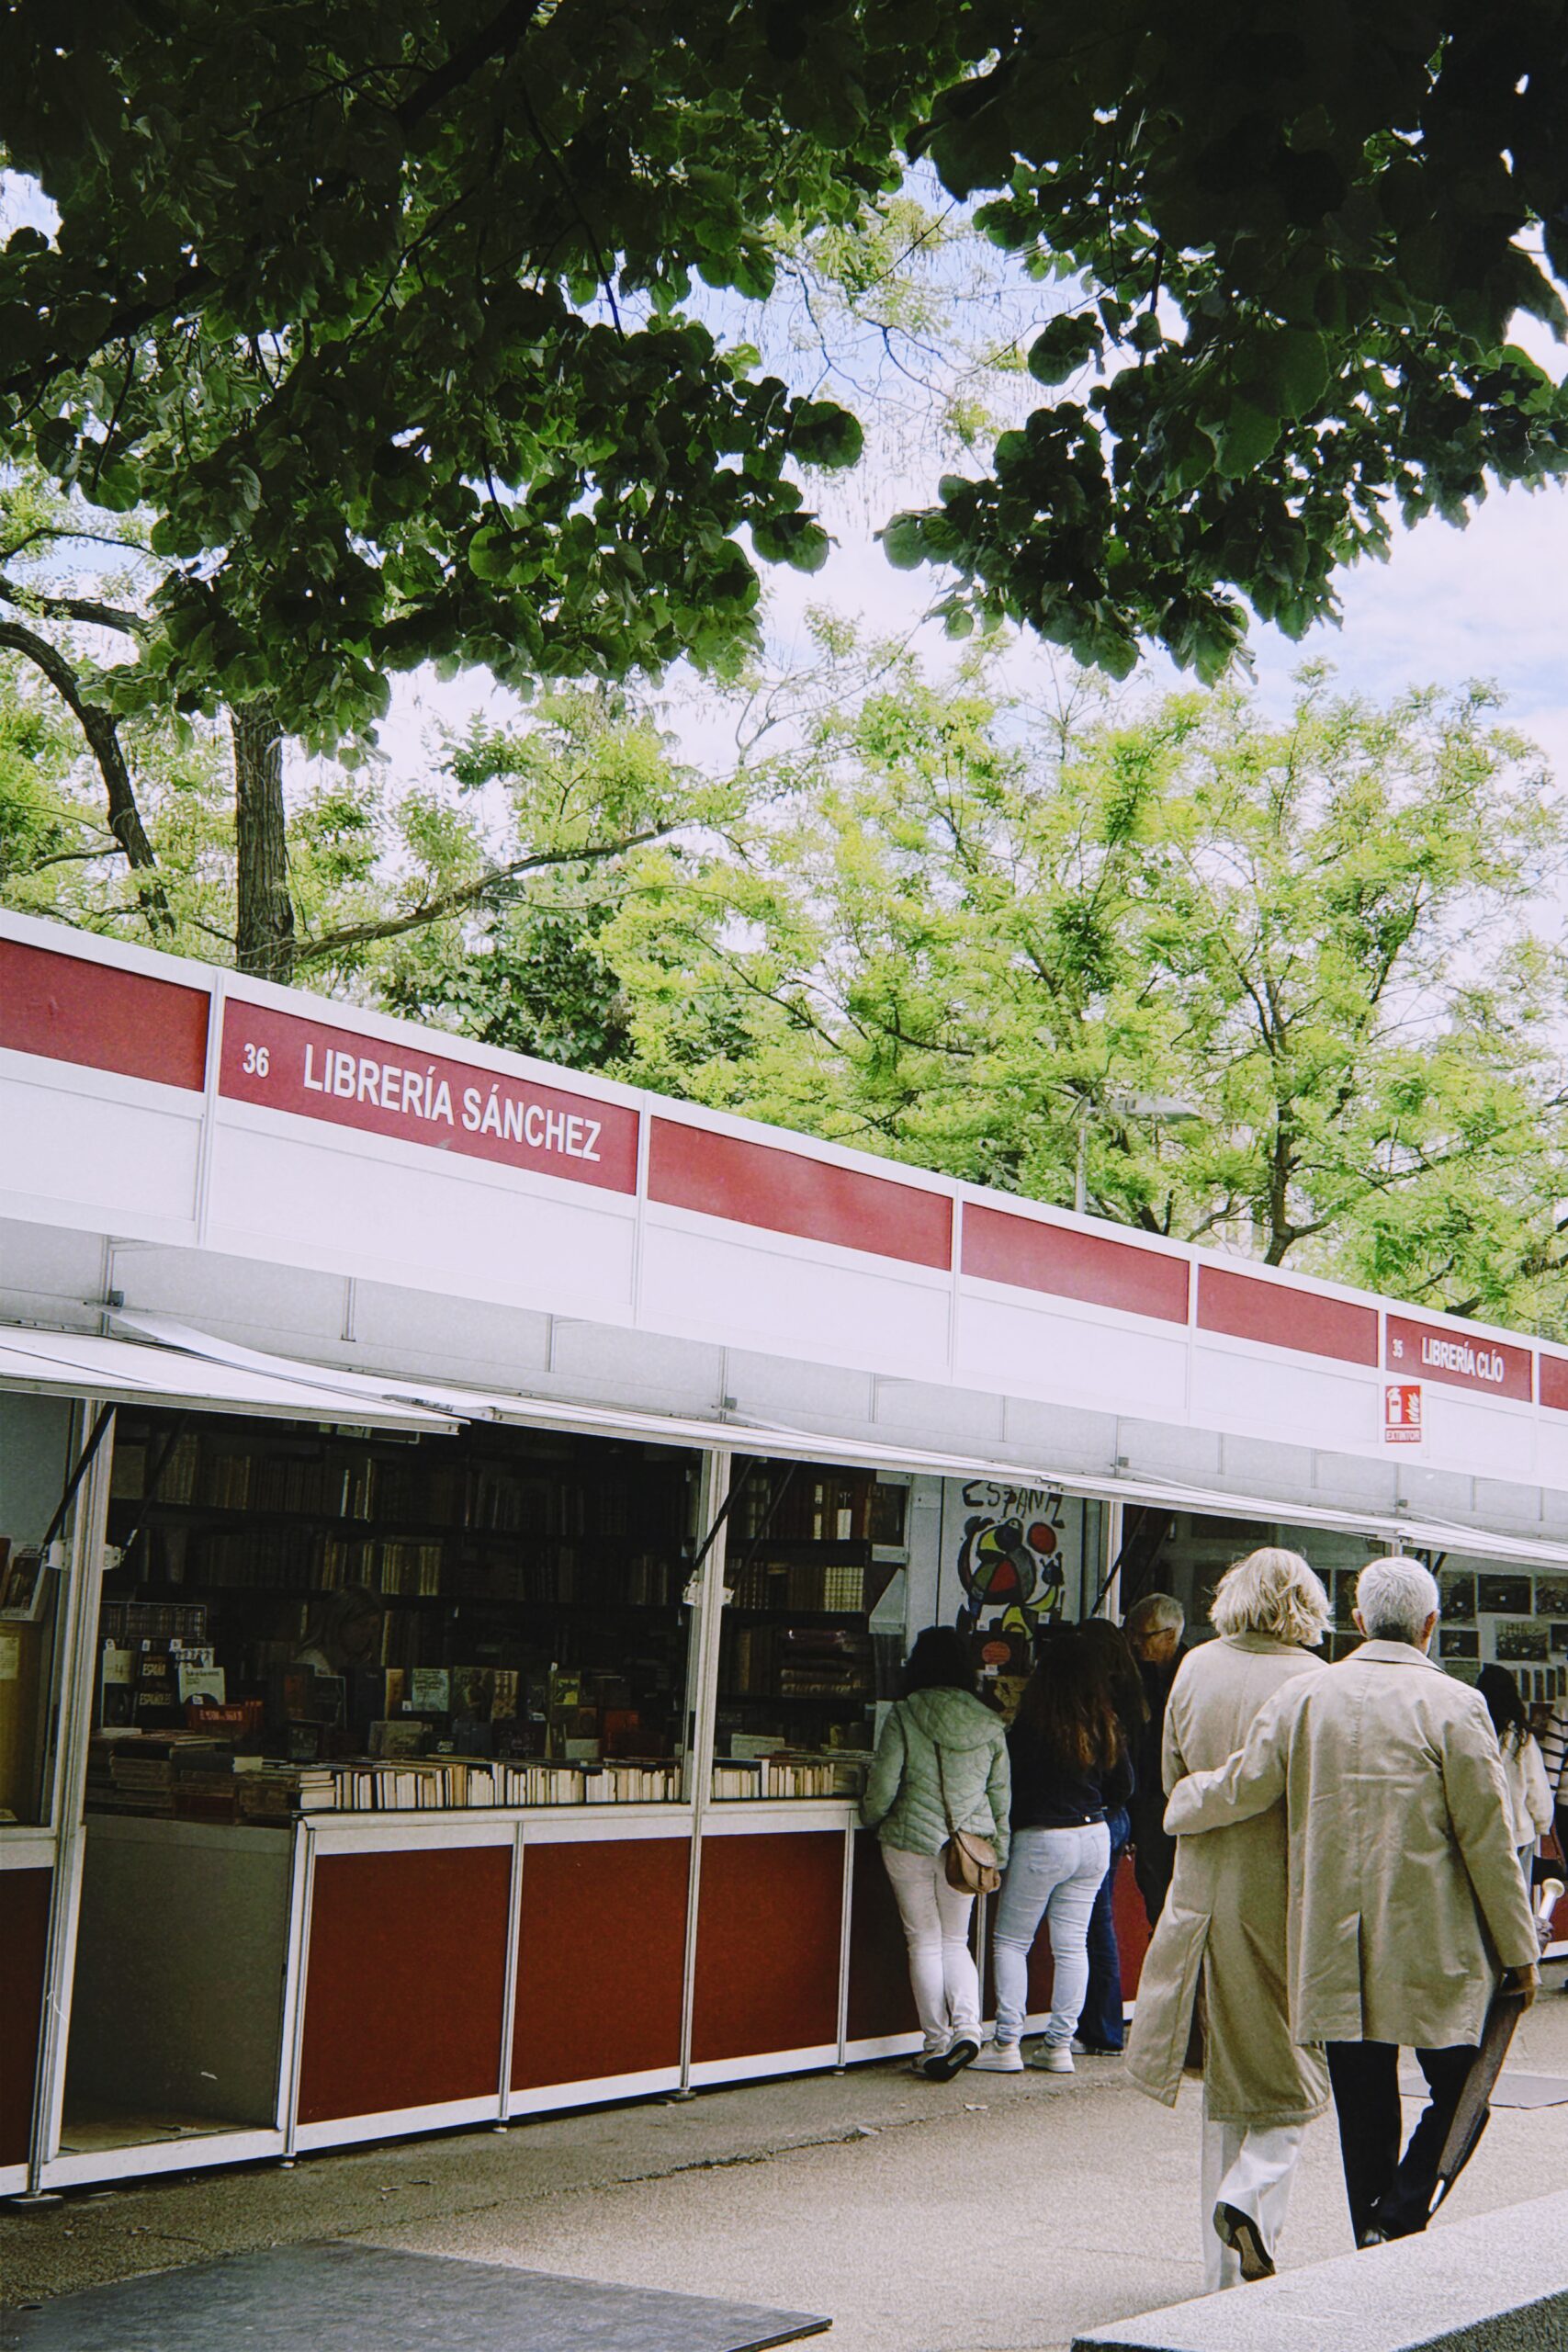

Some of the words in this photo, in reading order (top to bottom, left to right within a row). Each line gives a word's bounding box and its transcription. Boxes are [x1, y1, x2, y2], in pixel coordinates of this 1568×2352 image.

[243, 1042, 270, 1079] 36
[303, 1043, 455, 1126] LIBRERÍA
[461, 1084, 602, 1162] SÁNCHEZ
[1392, 1338, 1404, 1359] 35
[1421, 1337, 1476, 1377] LIBRERÍA
[1476, 1349, 1504, 1383] CLÍO
[1385, 1430, 1421, 1442] EXTINTOR
